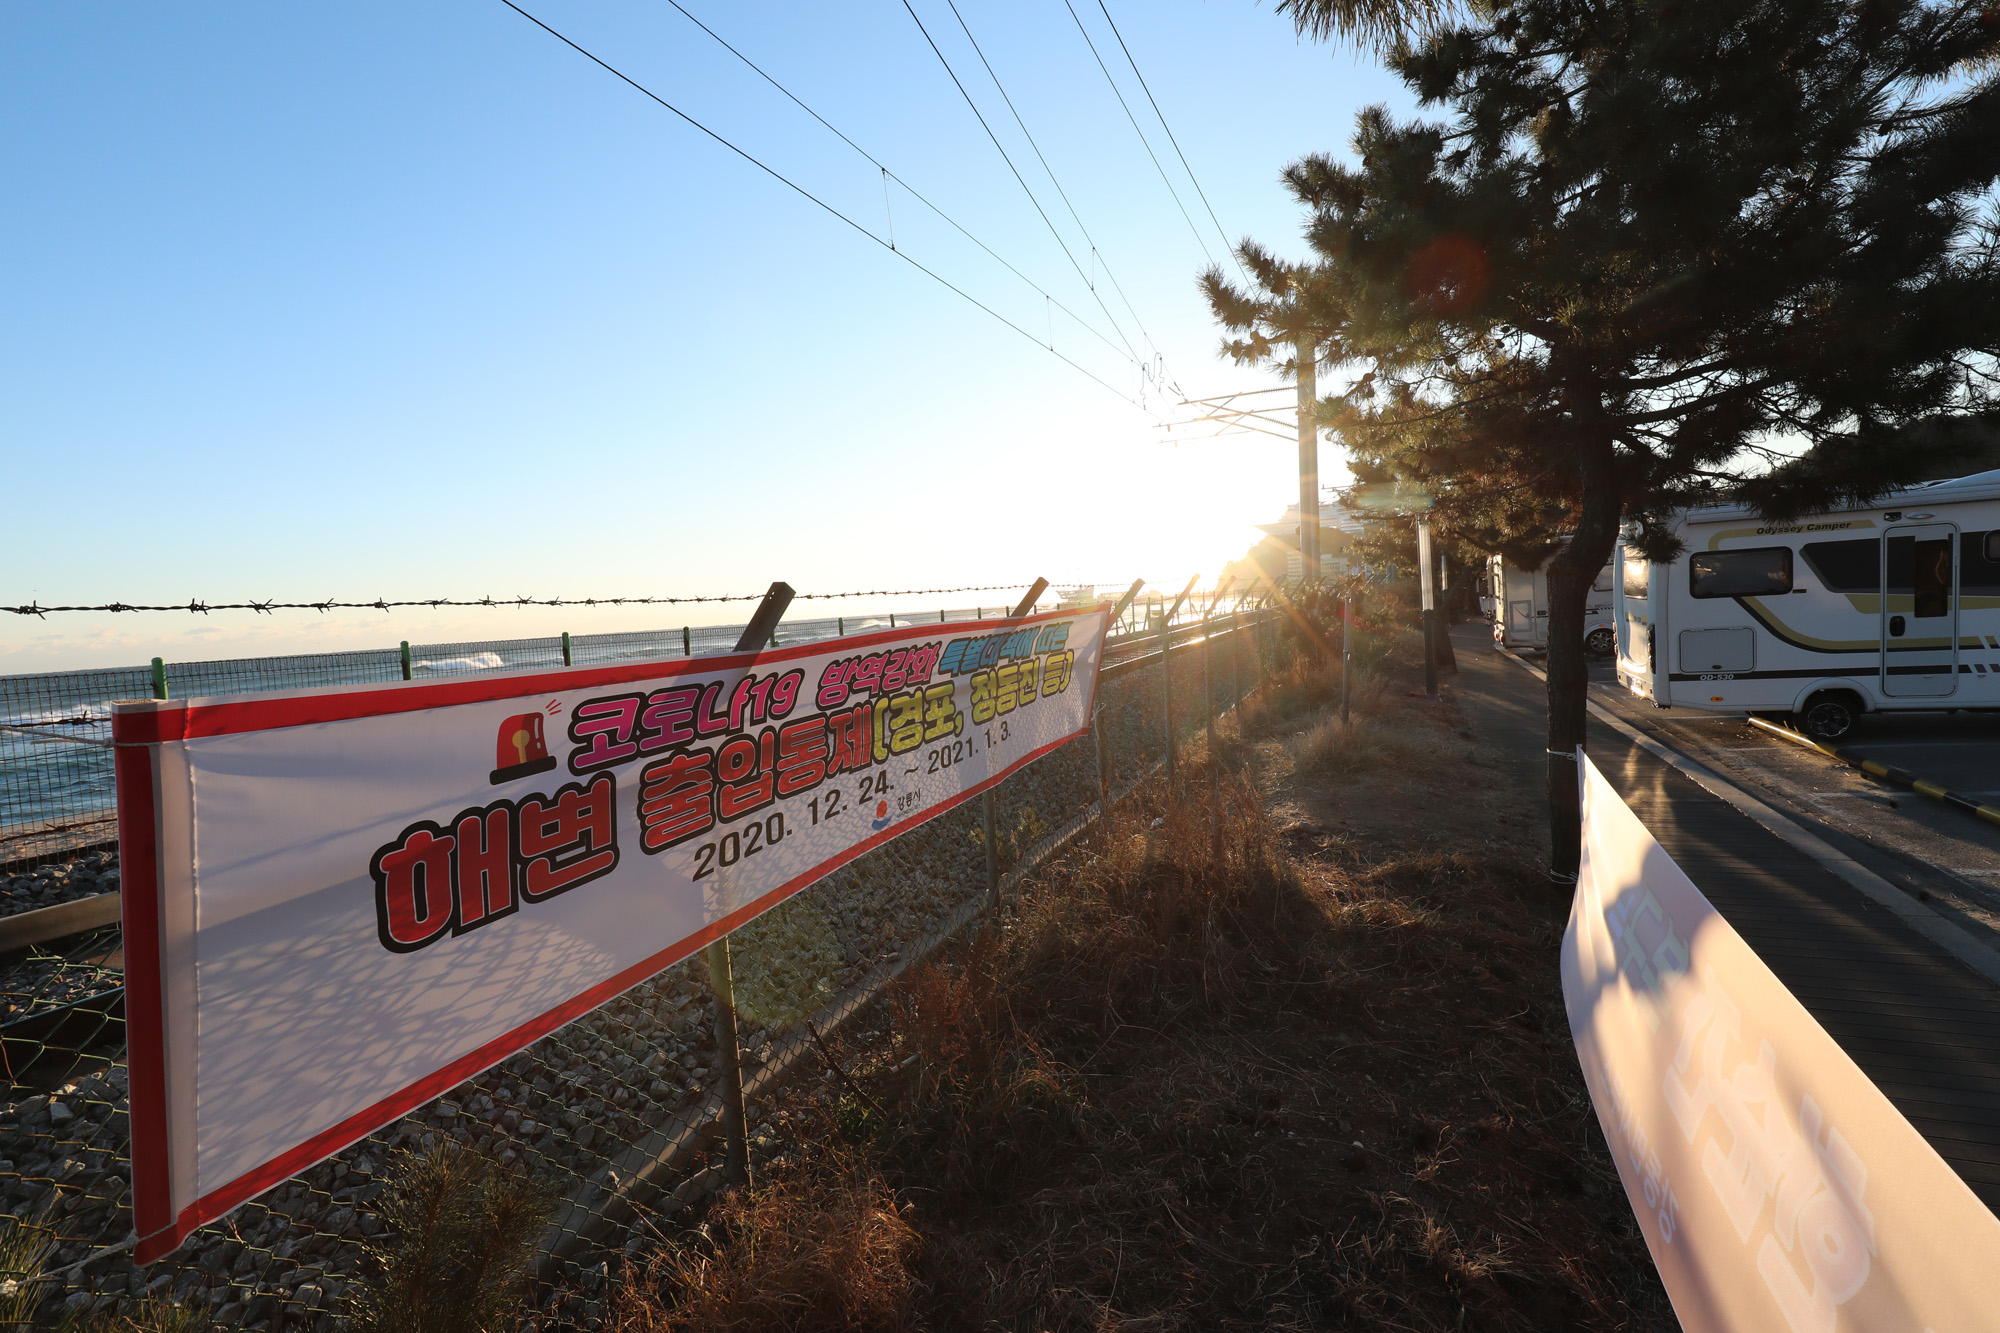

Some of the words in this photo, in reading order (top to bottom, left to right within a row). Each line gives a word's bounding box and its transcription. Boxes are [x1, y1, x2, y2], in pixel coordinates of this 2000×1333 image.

[1756, 524, 1804, 535] Odyssey
[1806, 521, 1852, 532] Camper
[568, 668, 805, 776] 코로나19
[816, 641, 943, 710] 방역강화
[938, 626, 1042, 677] 특별대책에
[1700, 673, 1734, 681] OD-530
[370, 770, 620, 953] 해변
[970, 659, 1040, 726] 정동진
[692, 812, 793, 882] 2020.
[807, 789, 848, 826] 12.
[858, 770, 895, 805] 24.
[927, 737, 979, 775] 2021.
[984, 730, 998, 747] 1.
[1000, 722, 1012, 741] 3.
